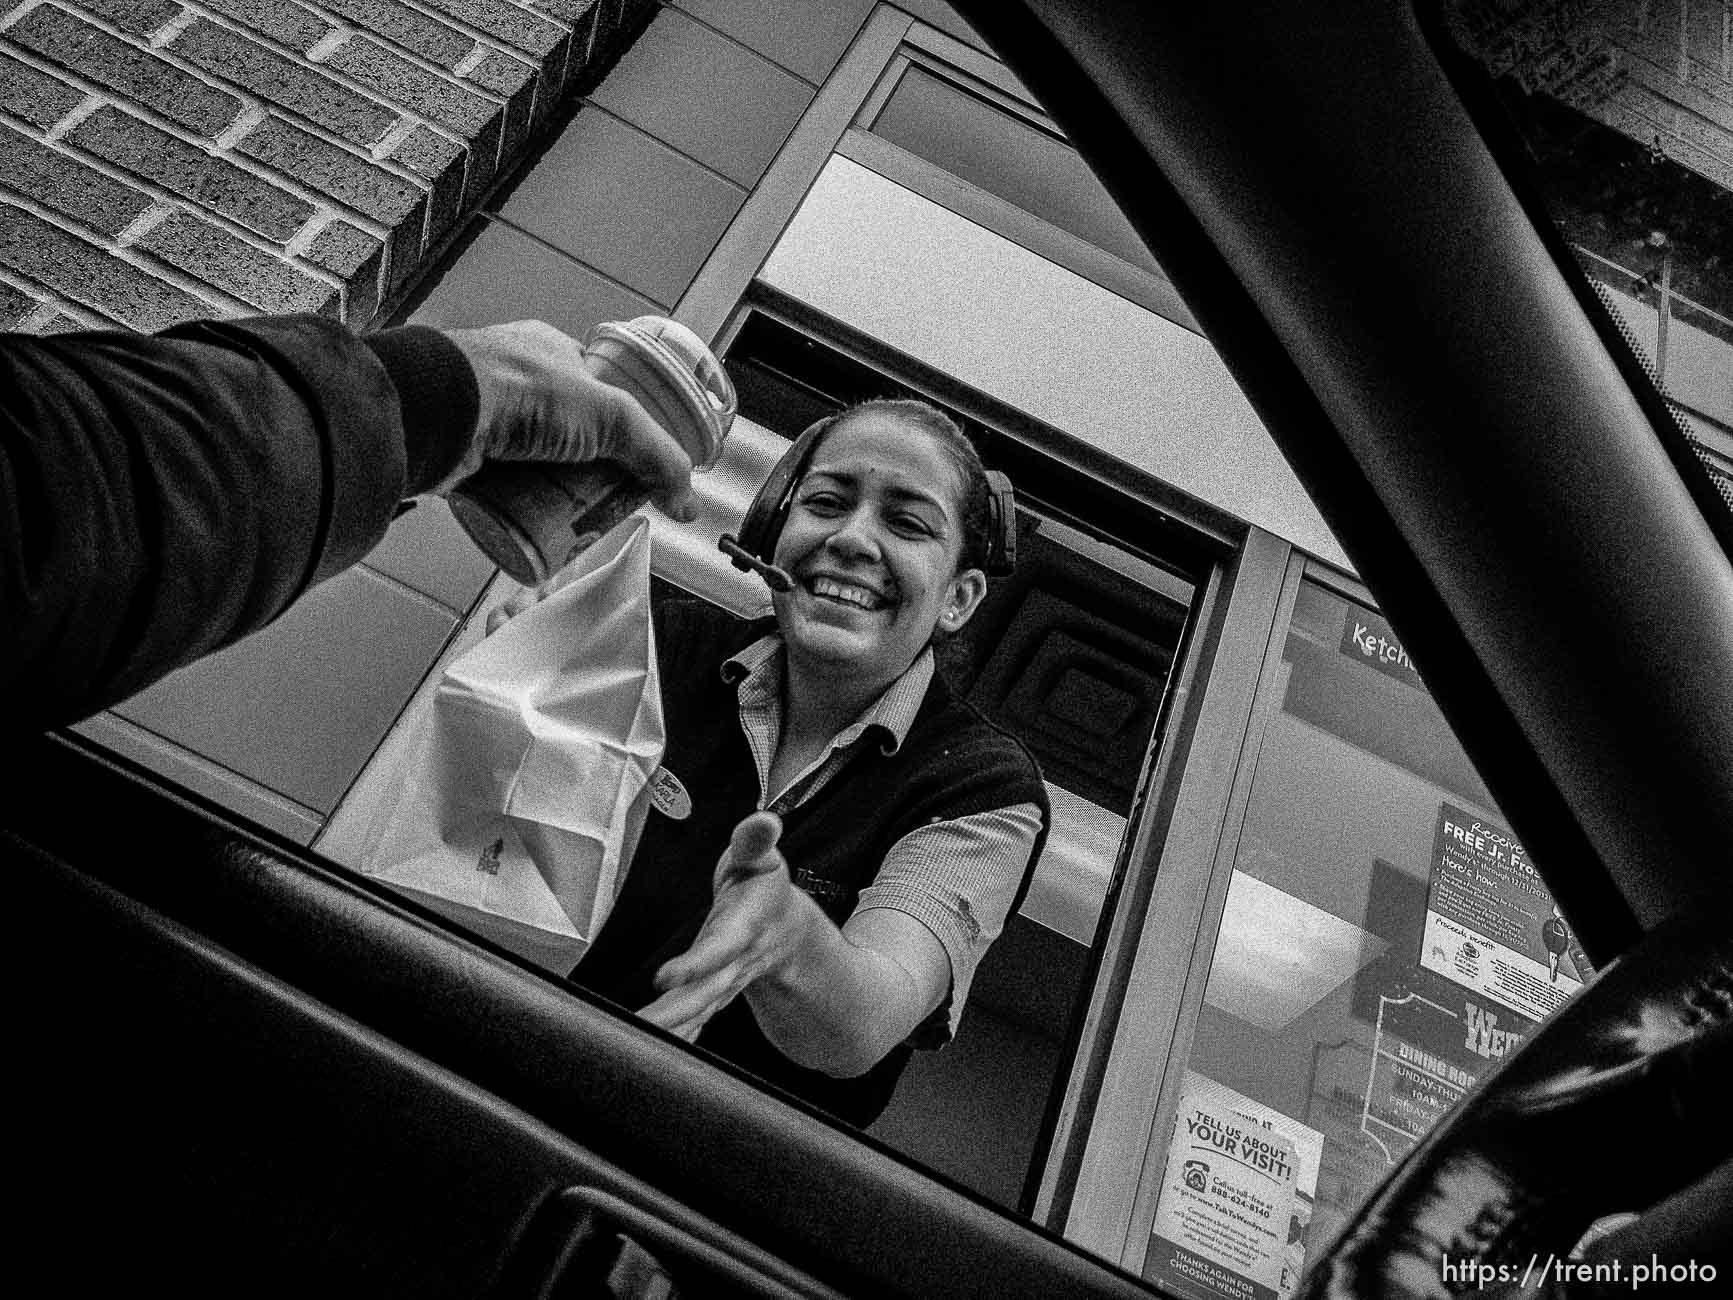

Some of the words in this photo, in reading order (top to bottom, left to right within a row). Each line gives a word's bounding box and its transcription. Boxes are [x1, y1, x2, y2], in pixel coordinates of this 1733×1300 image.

[1444, 821, 1484, 851] FREE
[1488, 845, 1506, 862] Jr.
[1471, 823, 1524, 854] Receive
[1442, 855, 1472, 877] Here's
[1400, 1043, 1446, 1076] DINING
[1188, 1118, 1236, 1154] YOUR
[1242, 1145, 1291, 1180] VISIT!
[1196, 1111, 1222, 1132] TELL
[1226, 1126, 1241, 1140] US
[1243, 1136, 1286, 1161] ABOUT
[1213, 1177, 1226, 1188] Call
[1170, 1259, 1214, 1285] CHOOSING
[1176, 1251, 1208, 1272] THANKS
[1210, 1269, 1235, 1285] AGAIN
[1237, 1280, 1253, 1293] FOR
